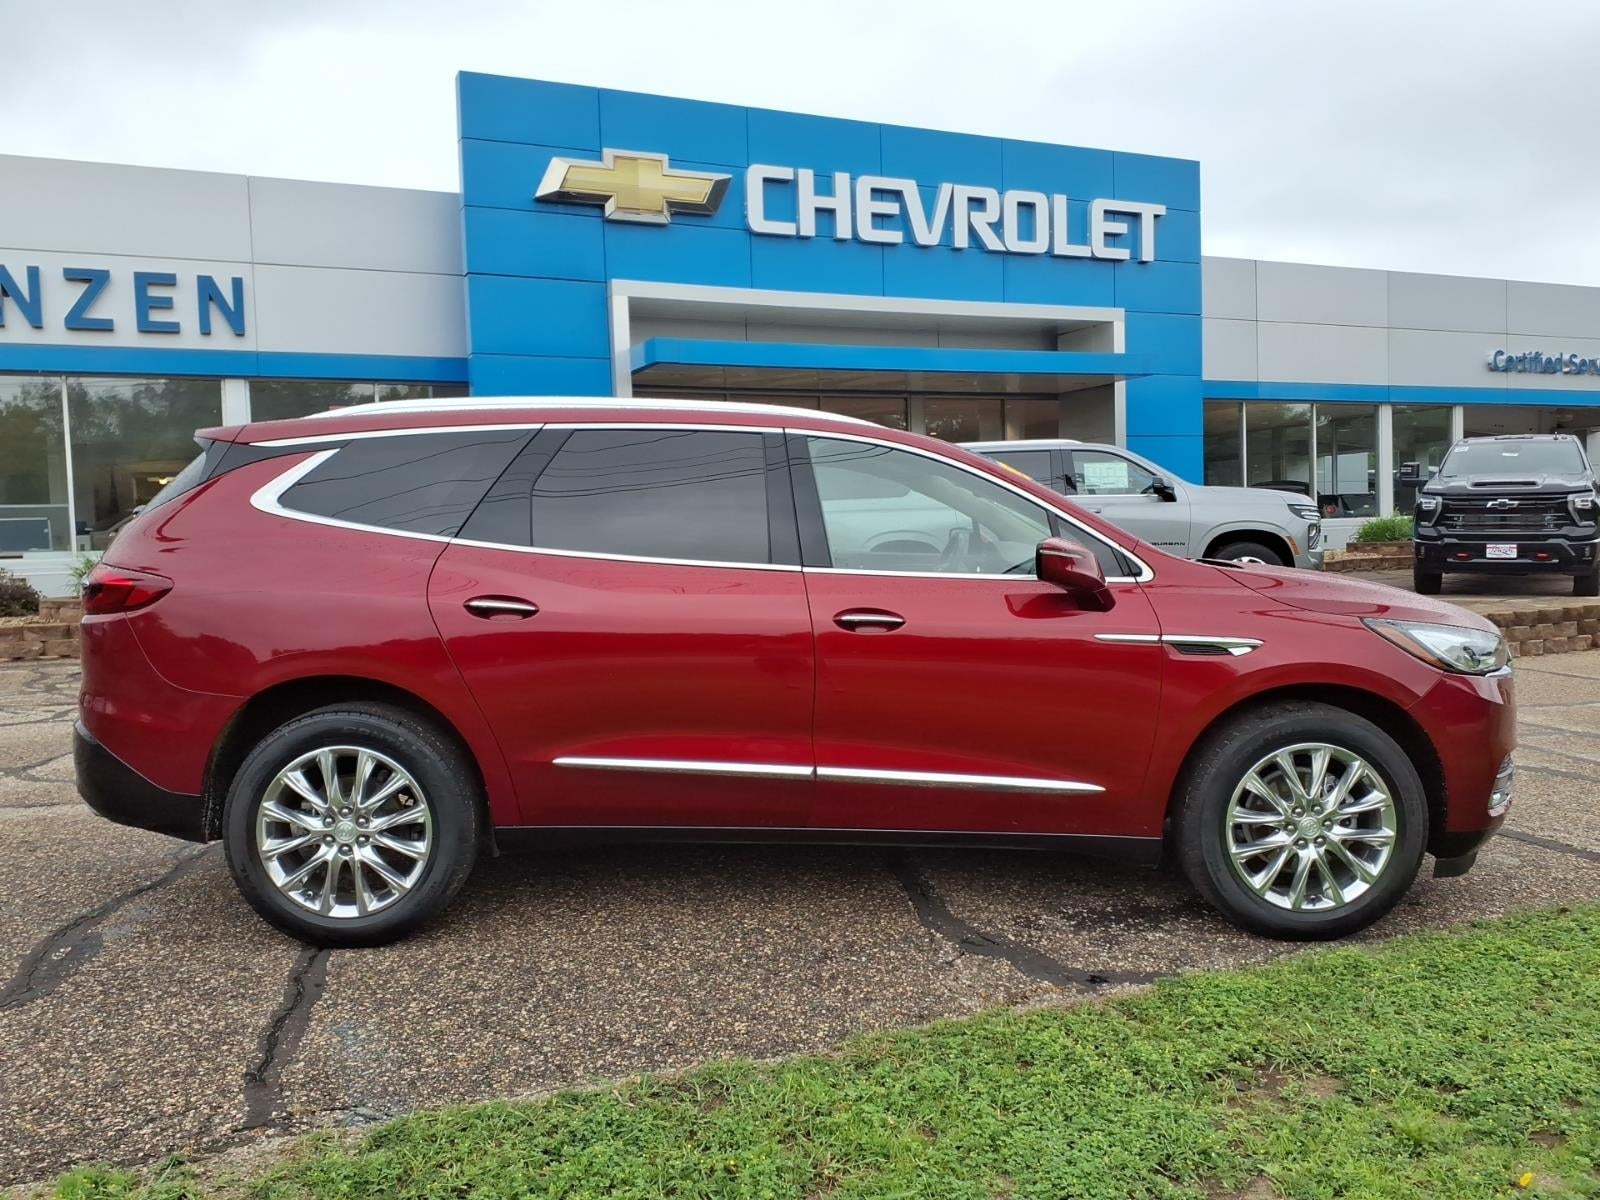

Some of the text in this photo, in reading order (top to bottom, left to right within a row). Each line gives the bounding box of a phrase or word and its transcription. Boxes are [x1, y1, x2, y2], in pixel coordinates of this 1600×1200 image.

[745, 163, 1167, 263] CHEVROLET
[0, 263, 245, 337] NZEN
[1487, 349, 1563, 374] Certified
